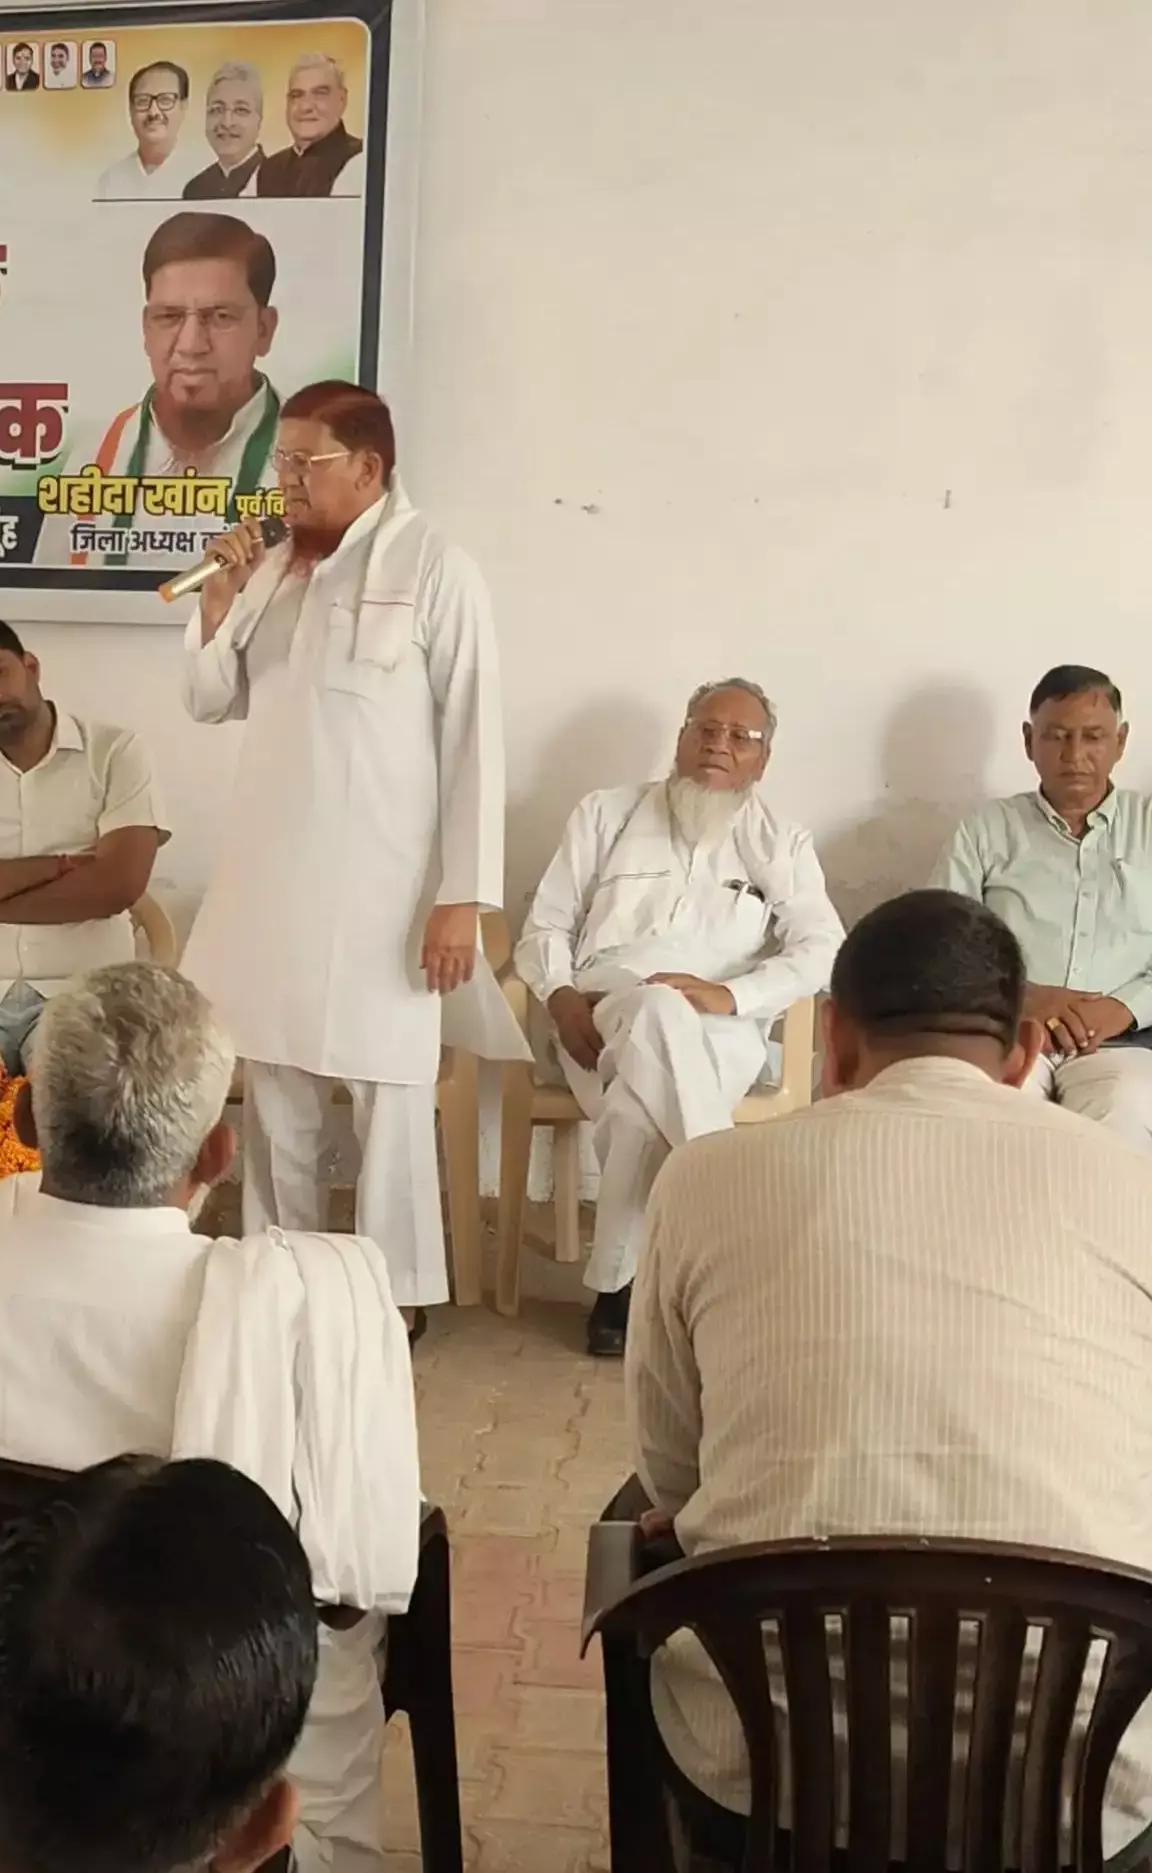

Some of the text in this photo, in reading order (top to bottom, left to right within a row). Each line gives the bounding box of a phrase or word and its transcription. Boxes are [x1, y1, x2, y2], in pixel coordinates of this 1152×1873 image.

[37, 464, 139, 515] शहीदा
[71, 523, 125, 551] जिला
[128, 531, 195, 552] अध्यक्ष
